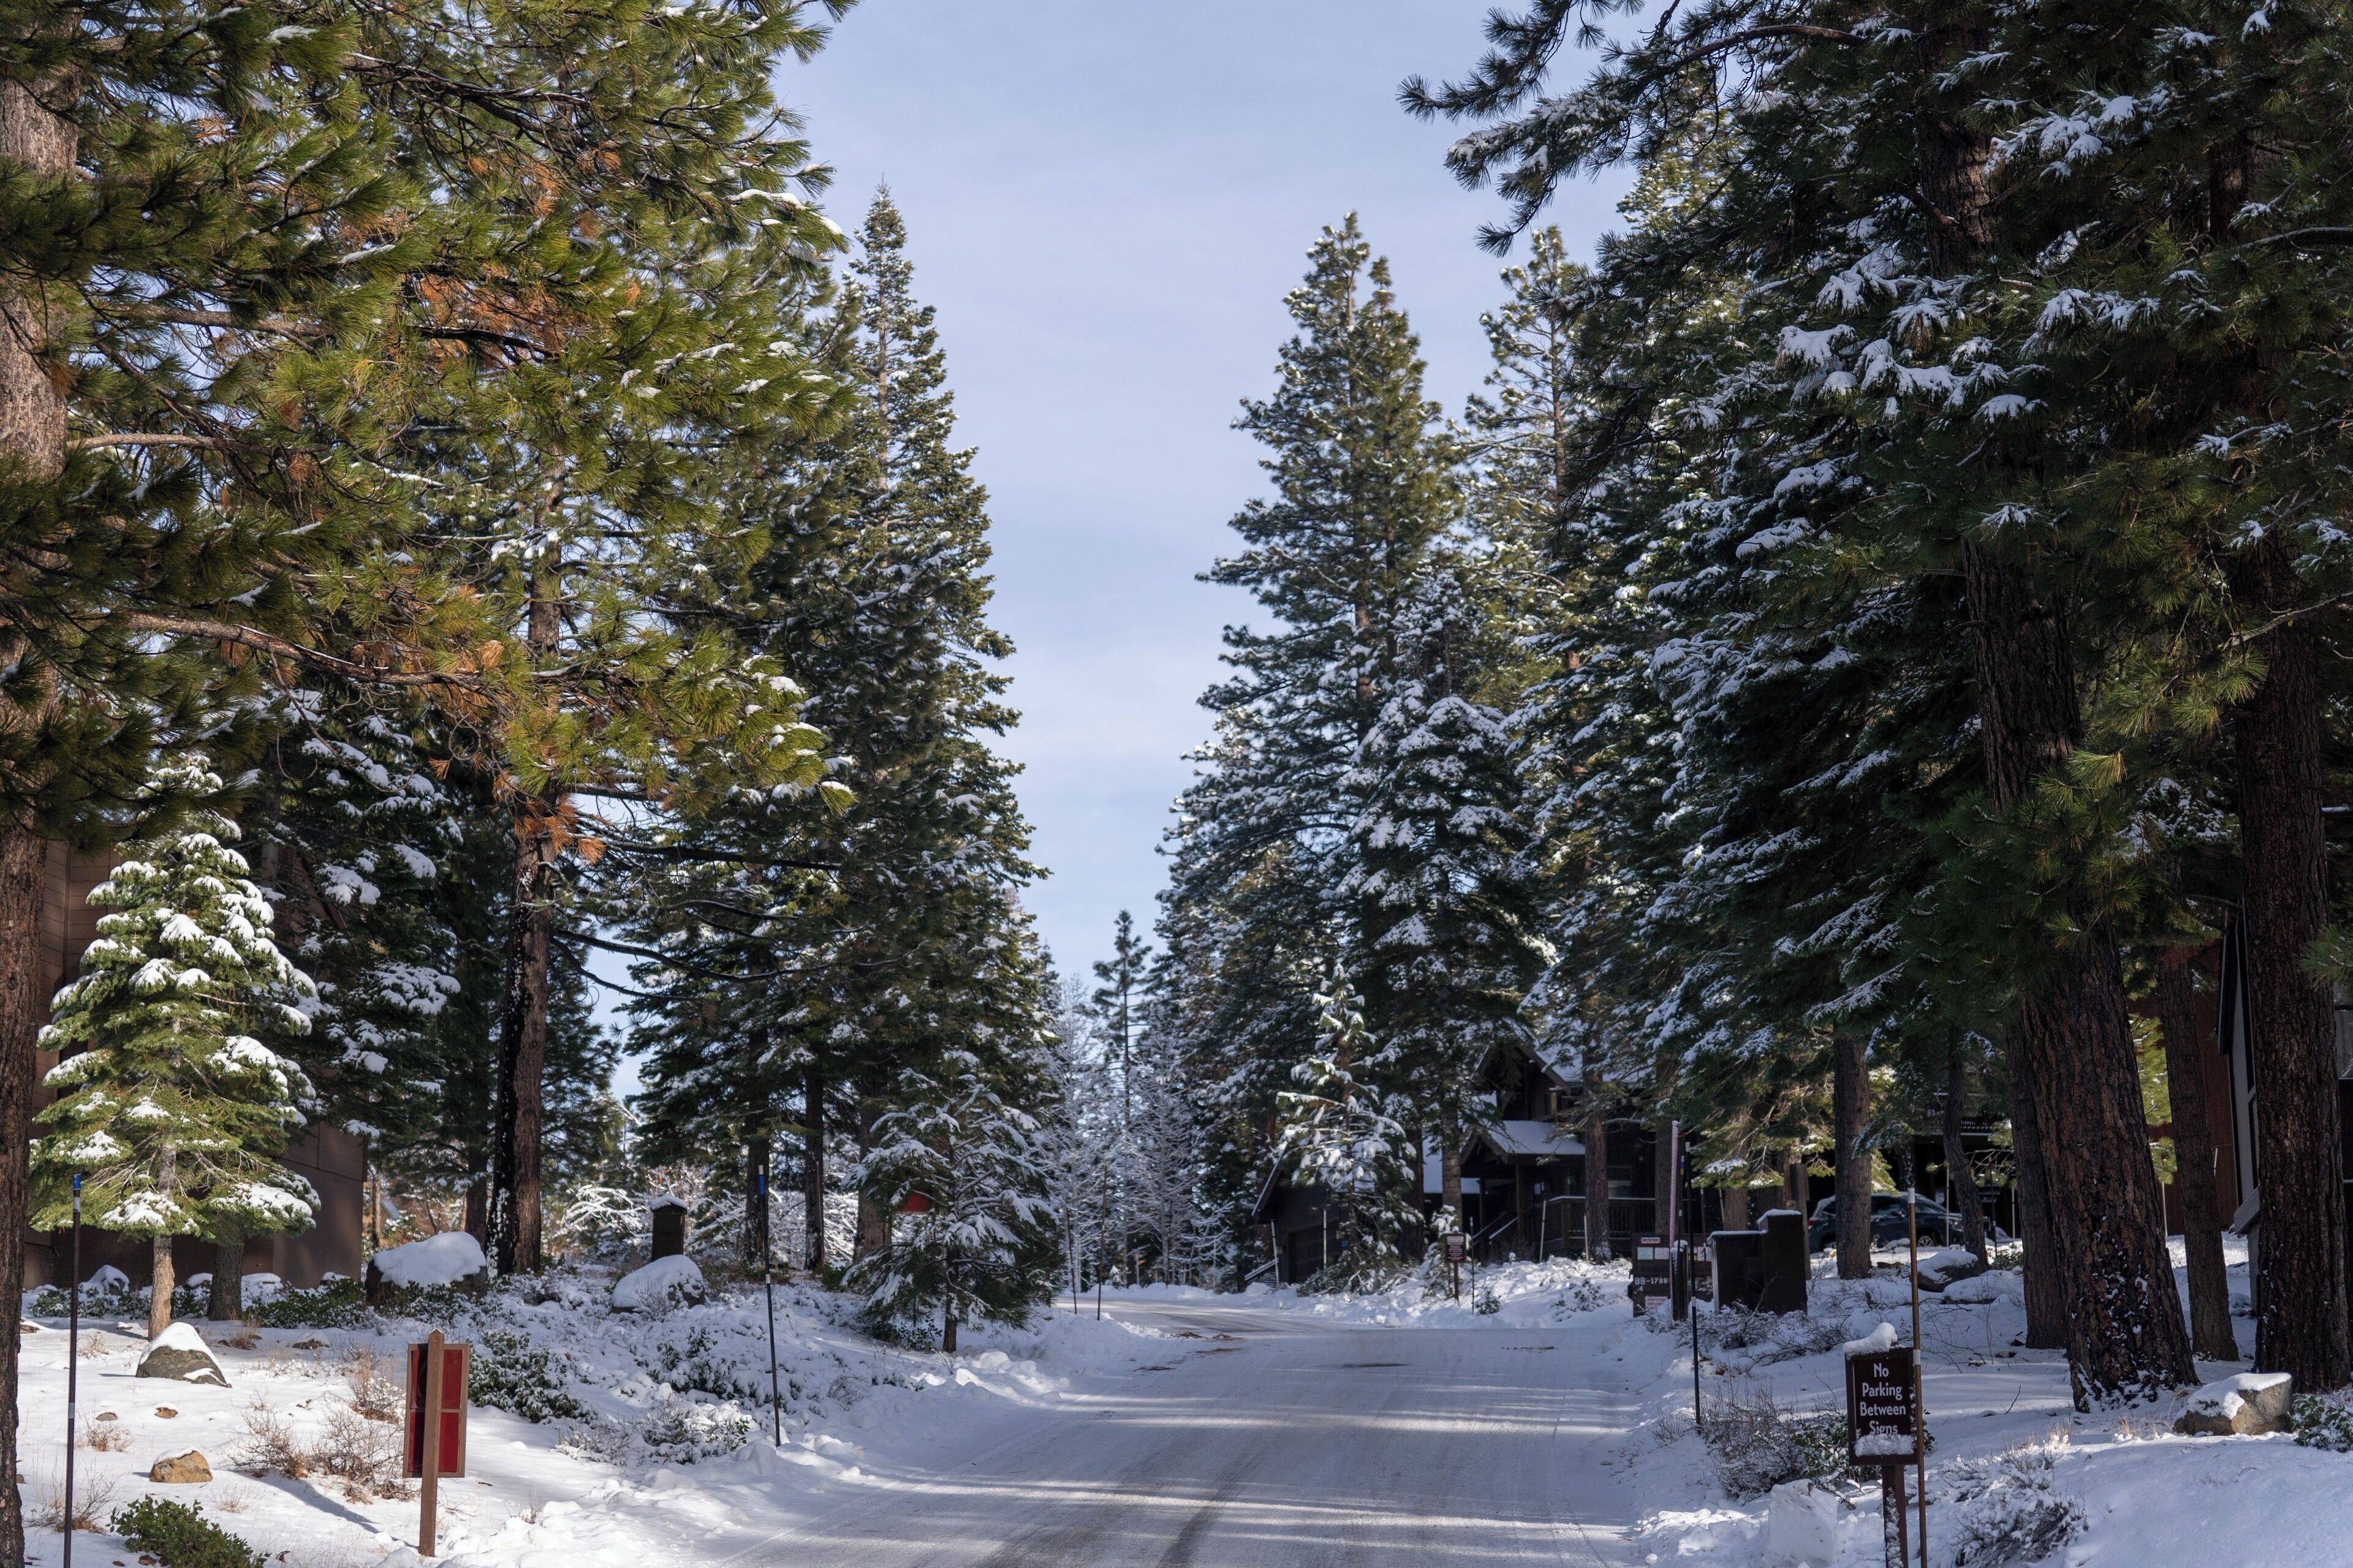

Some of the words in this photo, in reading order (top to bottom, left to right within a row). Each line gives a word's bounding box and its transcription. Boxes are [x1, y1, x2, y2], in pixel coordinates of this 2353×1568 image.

[1873, 1363, 1889, 1377] No
[1862, 1382, 1903, 1401] Parking
[1860, 1401, 1906, 1417] Between
[1869, 1420, 1898, 1434] Signs
